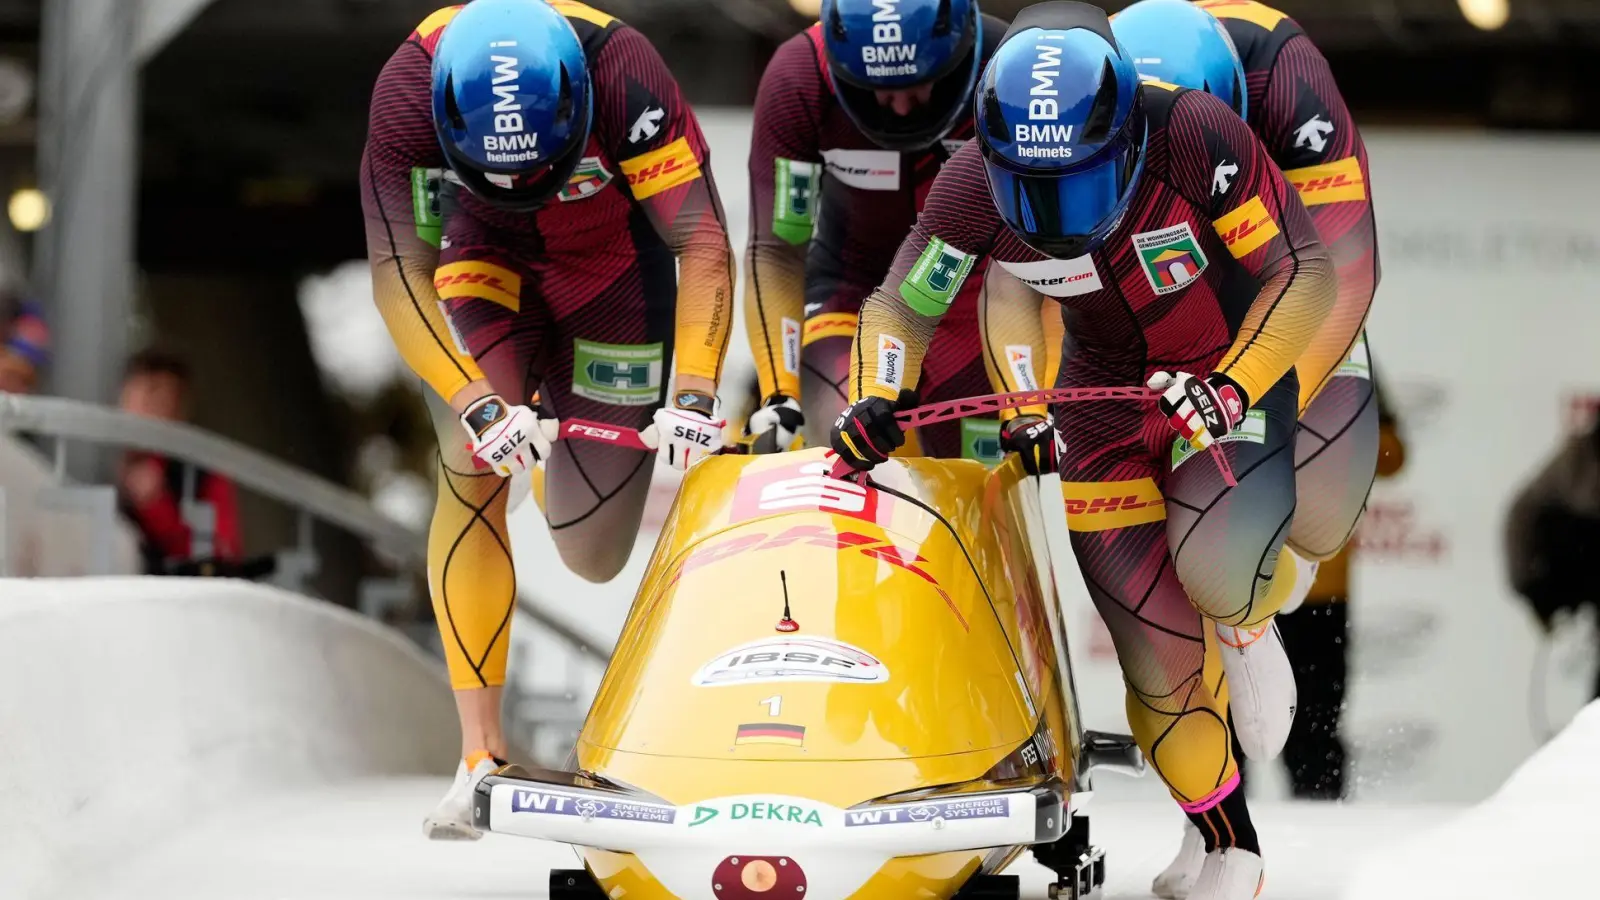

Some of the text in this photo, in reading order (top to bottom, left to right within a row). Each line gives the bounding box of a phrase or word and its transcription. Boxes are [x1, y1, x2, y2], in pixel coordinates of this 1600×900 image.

[862, 44, 917, 63] BMW
[865, 63, 918, 77] helmets
[1029, 45, 1062, 120] BMW
[490, 55, 524, 133] BMW
[483, 132, 538, 150] BMW
[1015, 124, 1073, 142] BMW
[486, 151, 539, 162] helmets
[1018, 145, 1073, 158] helmets
[1146, 228, 1187, 242] WOHNUNGSBAU
[1220, 218, 1258, 246] HL
[1018, 272, 1094, 286] nster.com
[1191, 384, 1219, 428] SEIZ
[567, 423, 621, 440] FES
[673, 425, 712, 447] SEIZ
[491, 429, 526, 462] SEIZ
[1065, 495, 1147, 515] DHL
[727, 652, 856, 669] IBSF
[758, 695, 782, 717] 1
[1021, 743, 1038, 768] FES
[518, 791, 572, 812] WT
[614, 804, 669, 815] ENERGIE
[947, 799, 1001, 810] ENERGIE
[610, 809, 669, 822] SYSTEME
[730, 802, 823, 827] DEKRA
[850, 809, 904, 825] WT
[945, 805, 1004, 818] SYSTEME
